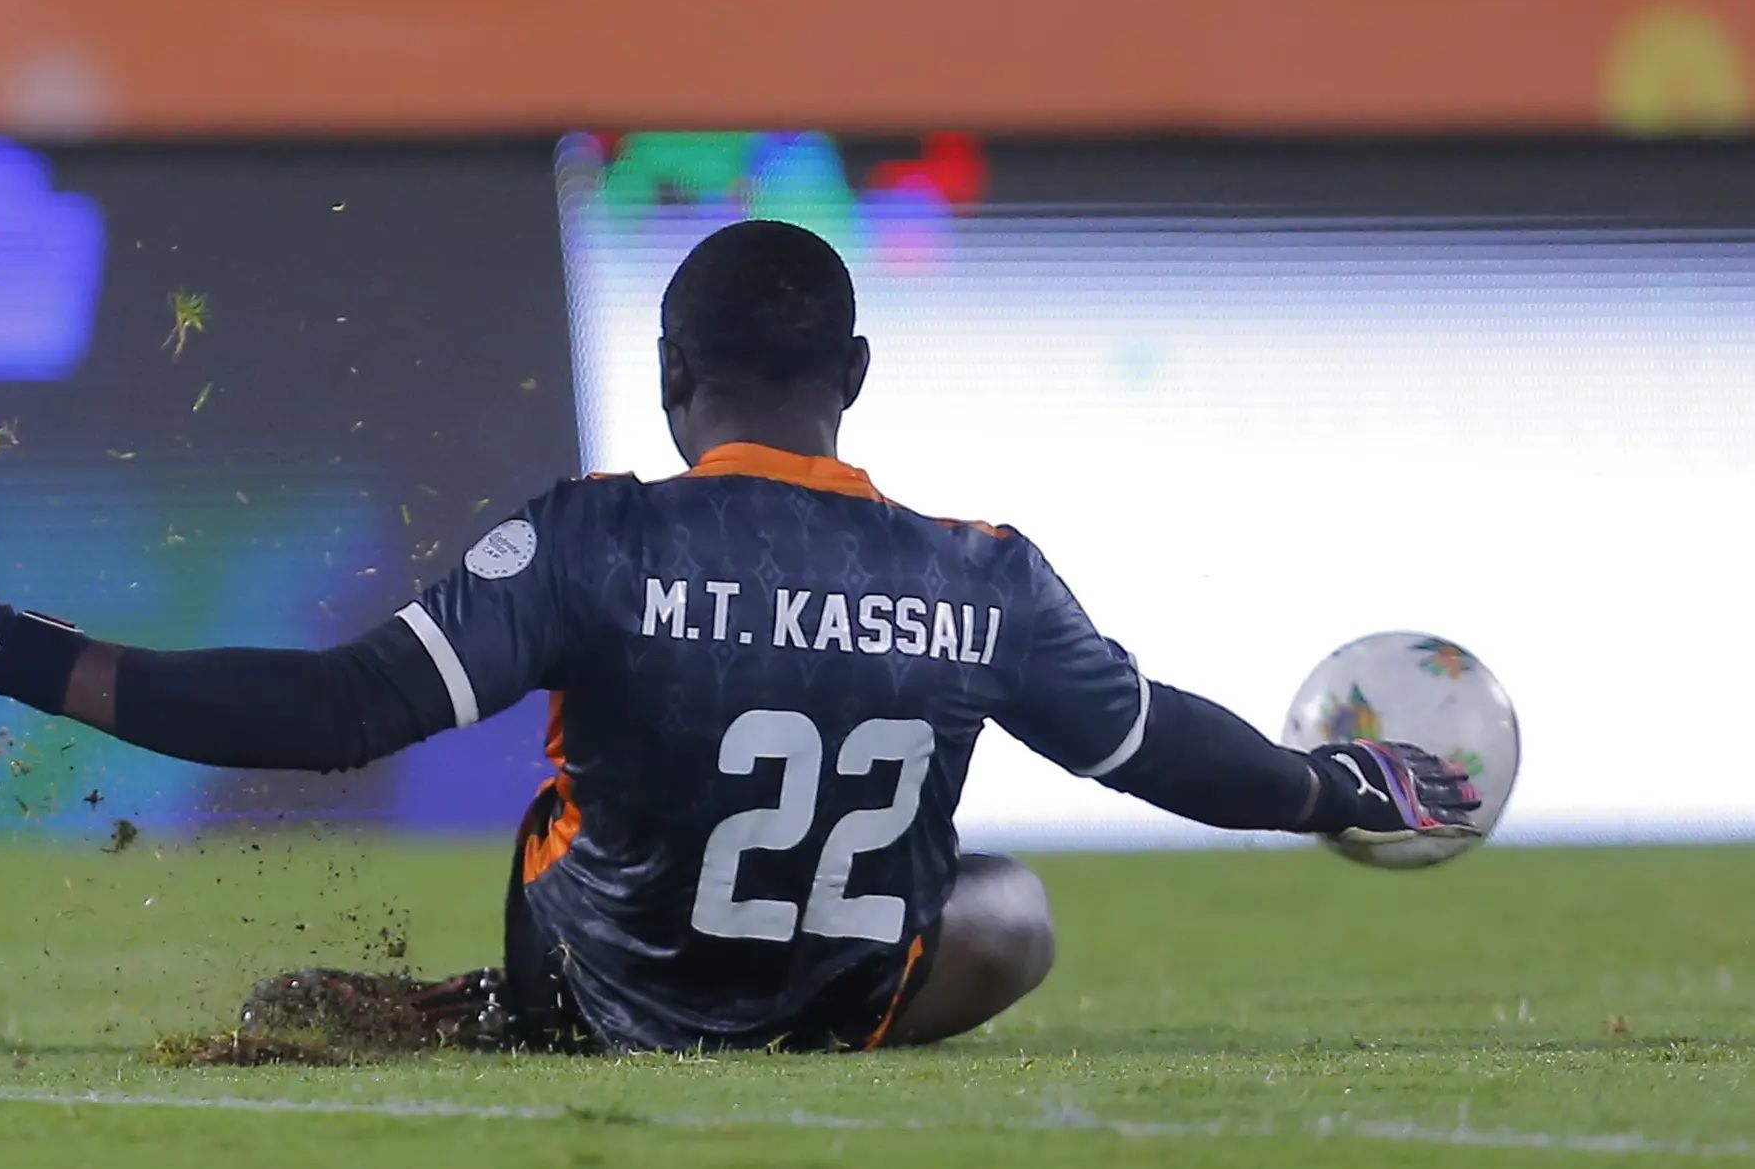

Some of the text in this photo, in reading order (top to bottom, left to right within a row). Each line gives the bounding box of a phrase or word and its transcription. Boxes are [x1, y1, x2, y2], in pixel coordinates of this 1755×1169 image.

[642, 578, 1001, 665] M.T. KASSALI
[691, 709, 935, 944] 22
